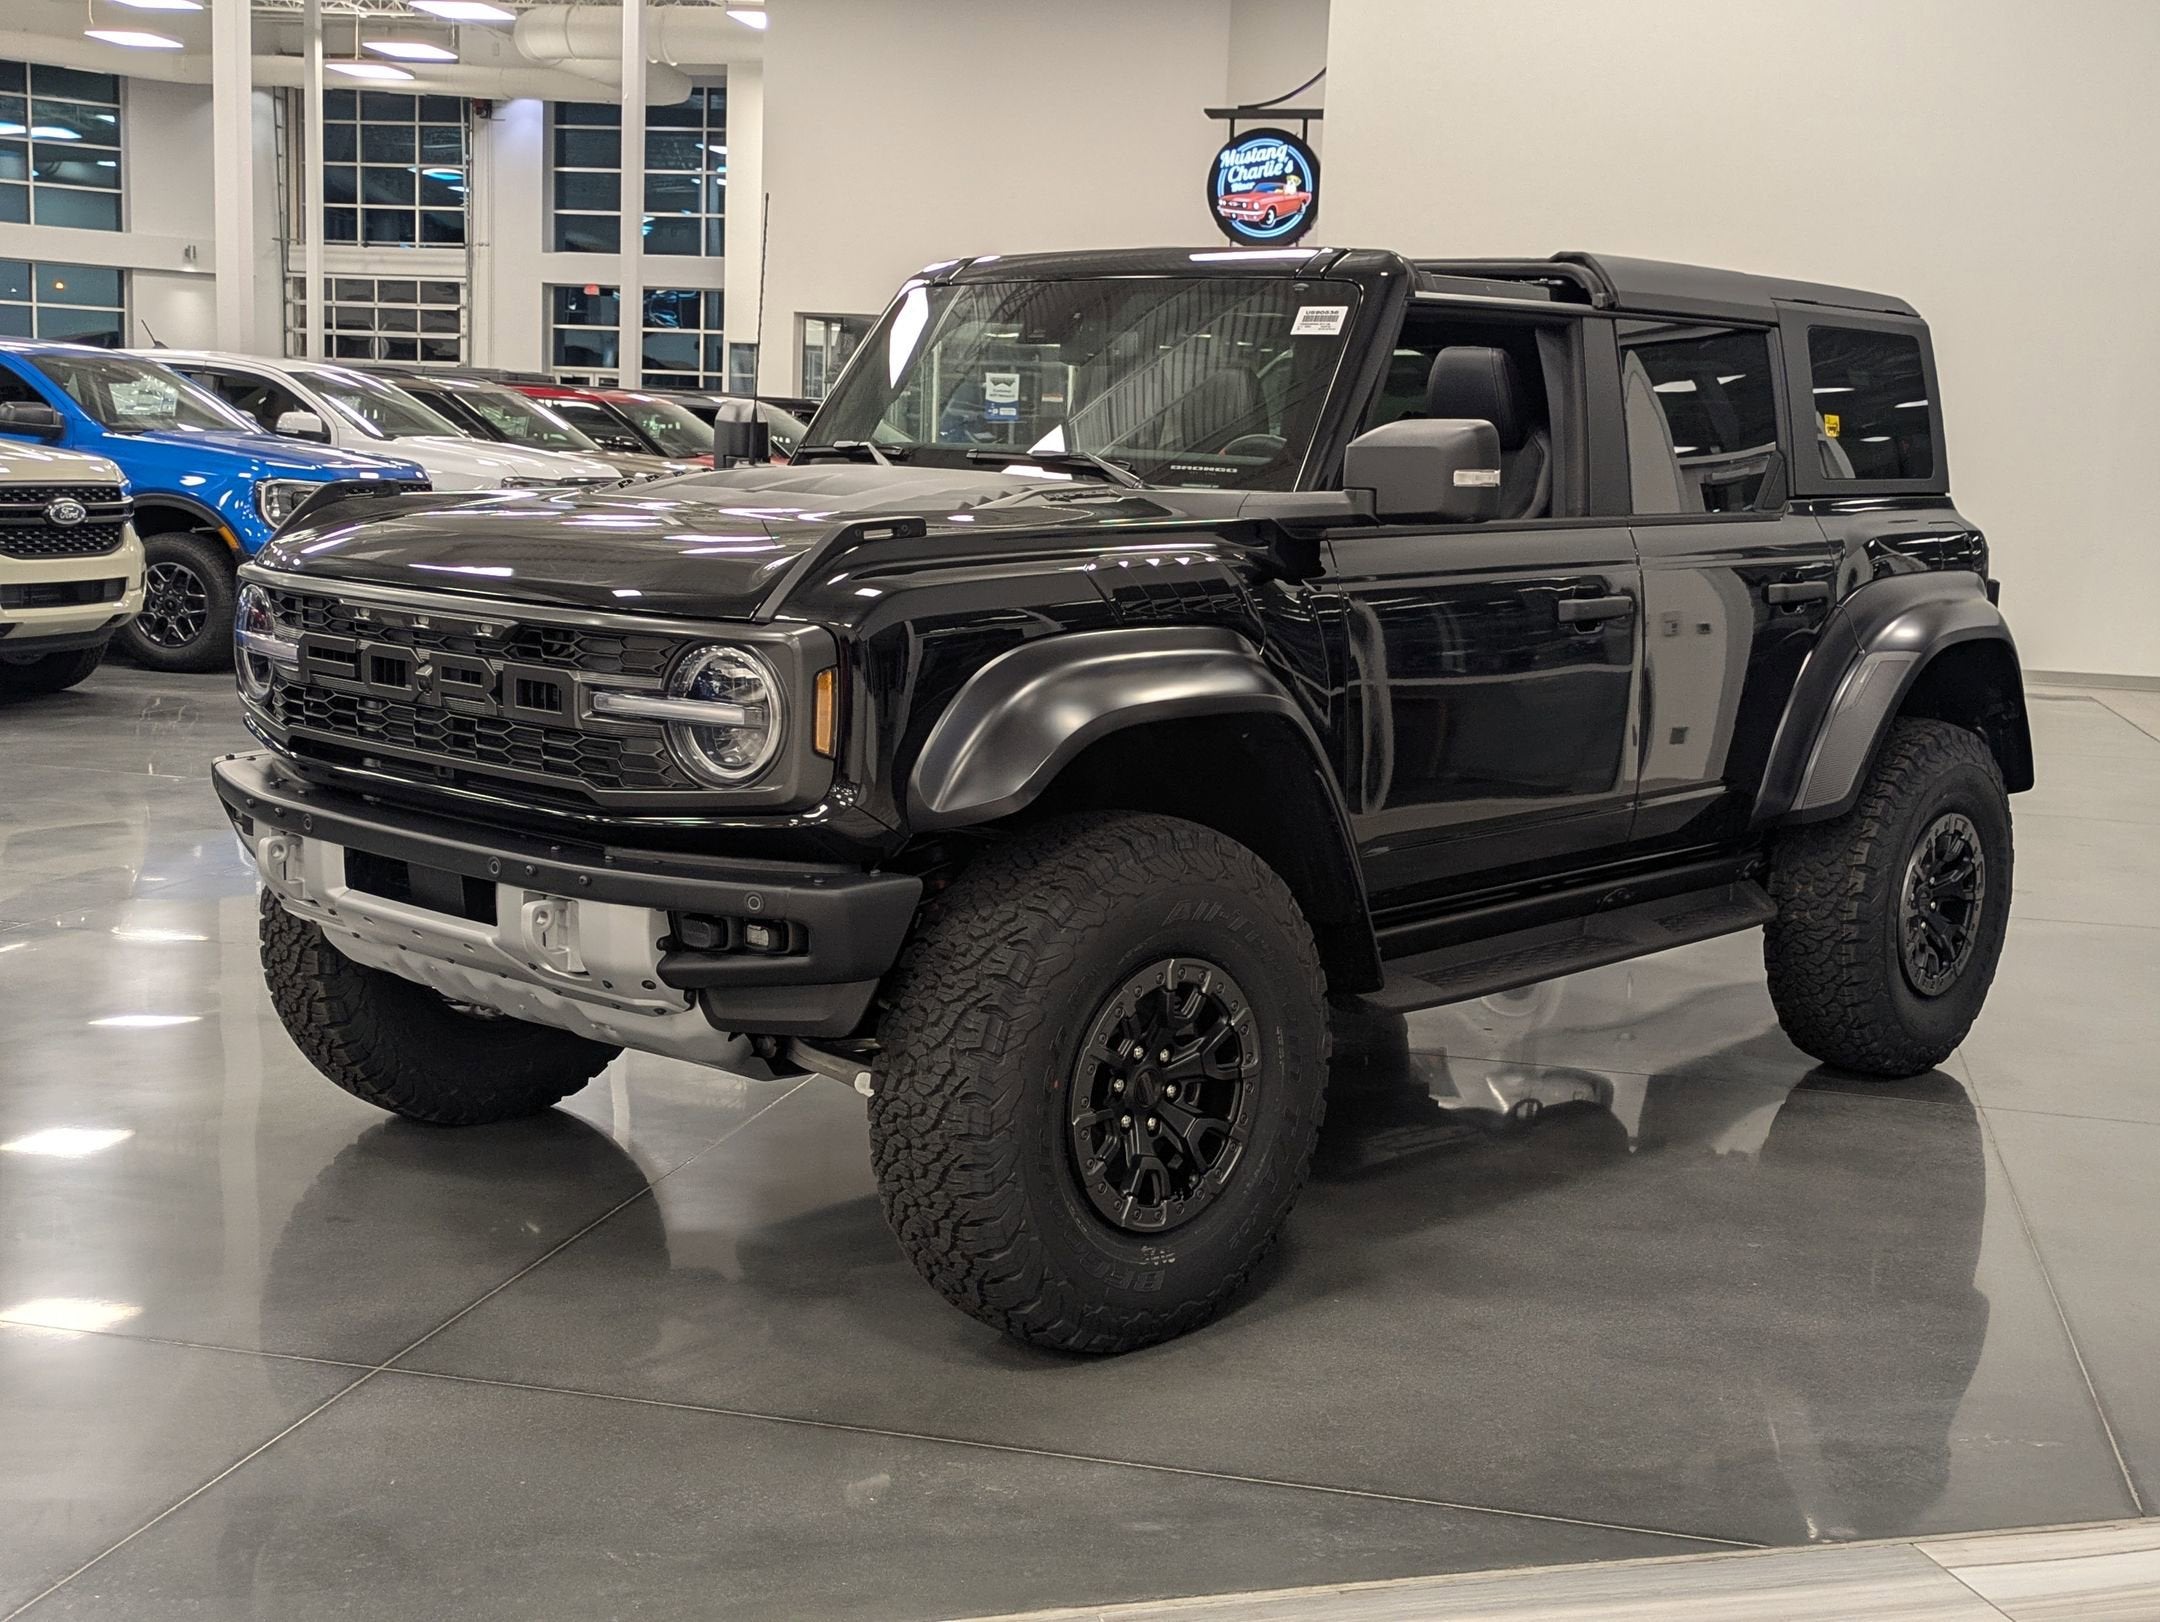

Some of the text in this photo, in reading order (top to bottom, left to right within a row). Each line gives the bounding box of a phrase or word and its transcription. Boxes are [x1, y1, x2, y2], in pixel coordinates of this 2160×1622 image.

[1220, 144, 1289, 168] Mustang
[1227, 160, 1294, 183] Charlie's
[1170, 465, 1238, 473] BRONCO
[60, 507, 79, 519] Ford
[298, 631, 584, 730] FORD
